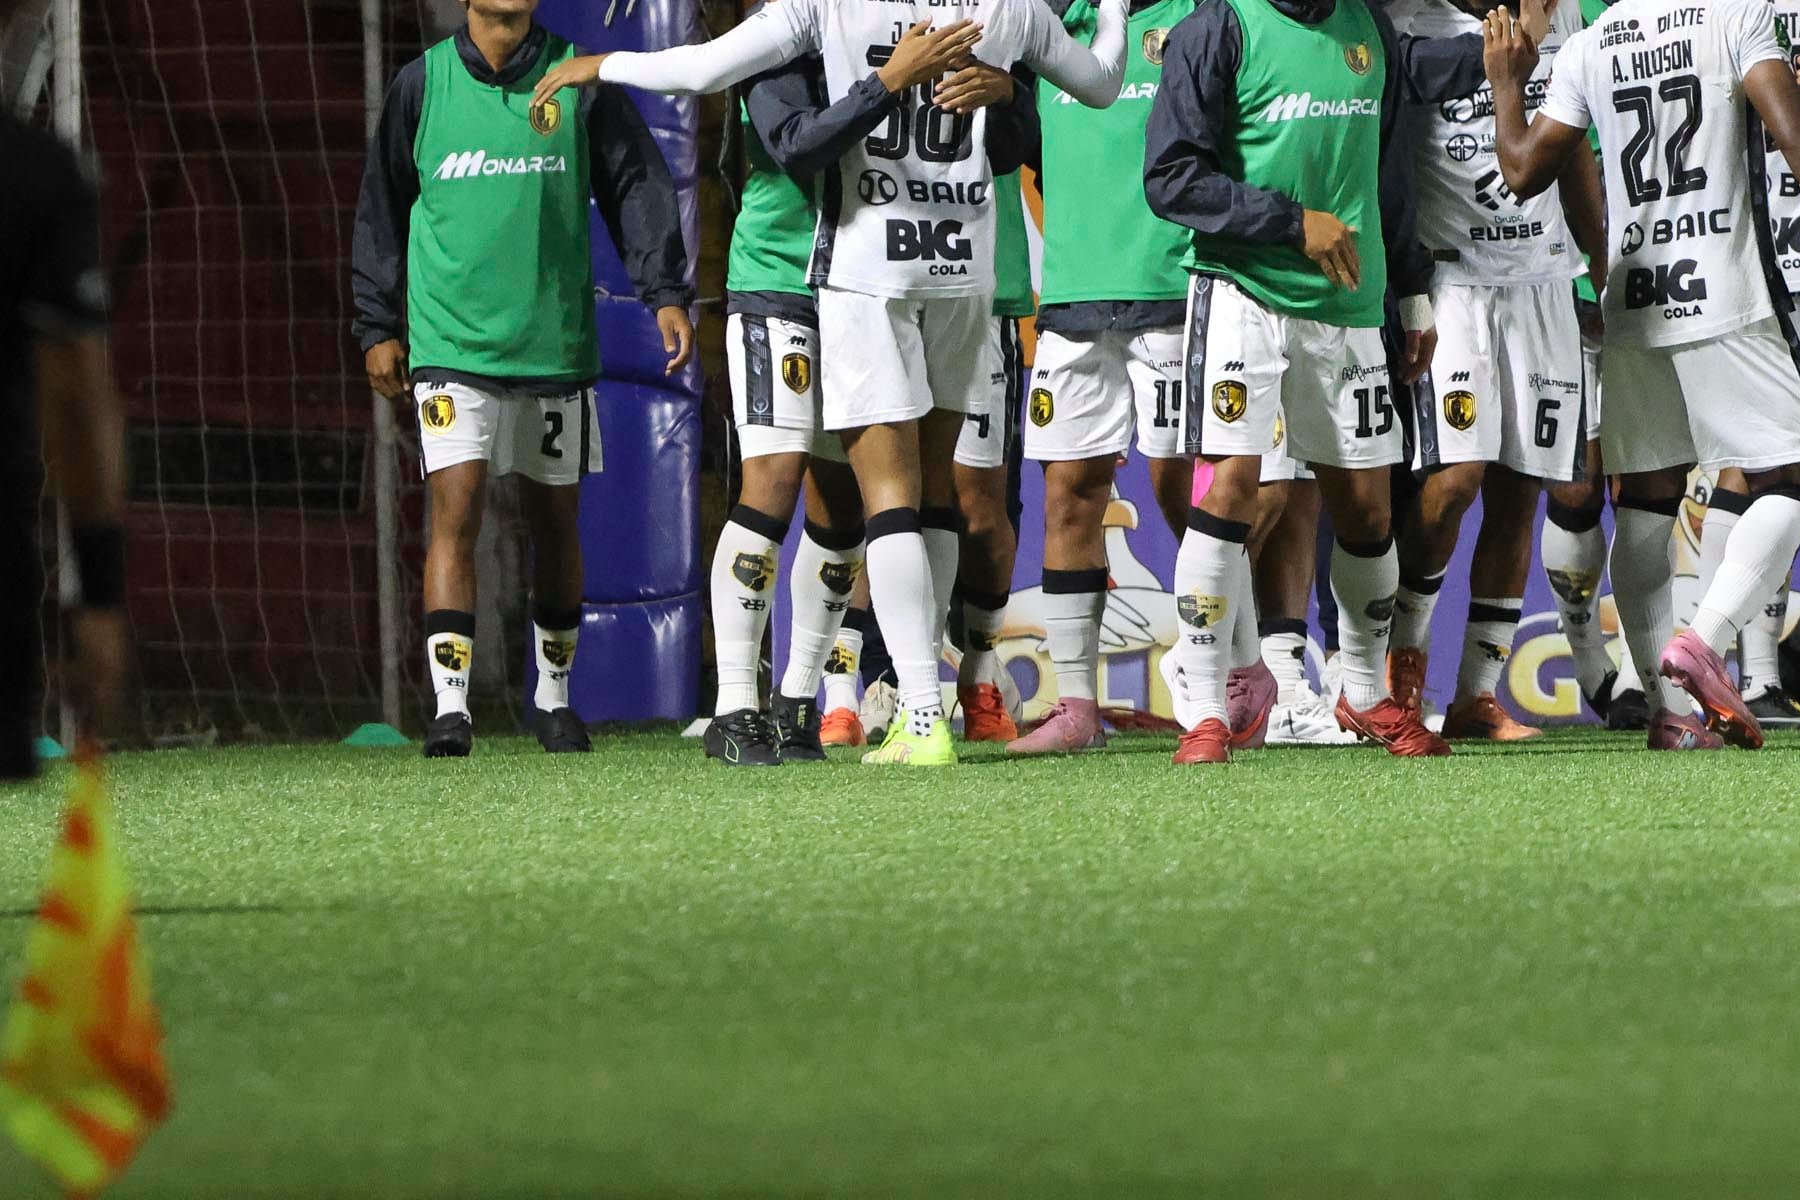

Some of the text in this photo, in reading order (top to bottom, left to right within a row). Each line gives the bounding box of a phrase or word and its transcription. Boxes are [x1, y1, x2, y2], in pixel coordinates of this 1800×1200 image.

[1600, 31, 1645, 50] LIBERIA
[1612, 39, 1693, 84] A. HUDSON
[1612, 74, 1708, 207] 22
[906, 179, 986, 206] BAIC
[886, 218, 973, 261] BIG
[1652, 208, 1731, 245] BAIC
[929, 263, 968, 277] COLA
[1625, 259, 1707, 310] BIG
[1663, 305, 1703, 320] COLA
[1353, 386, 1394, 437] 15
[1535, 398, 1561, 448] 6
[541, 412, 563, 458] 2
